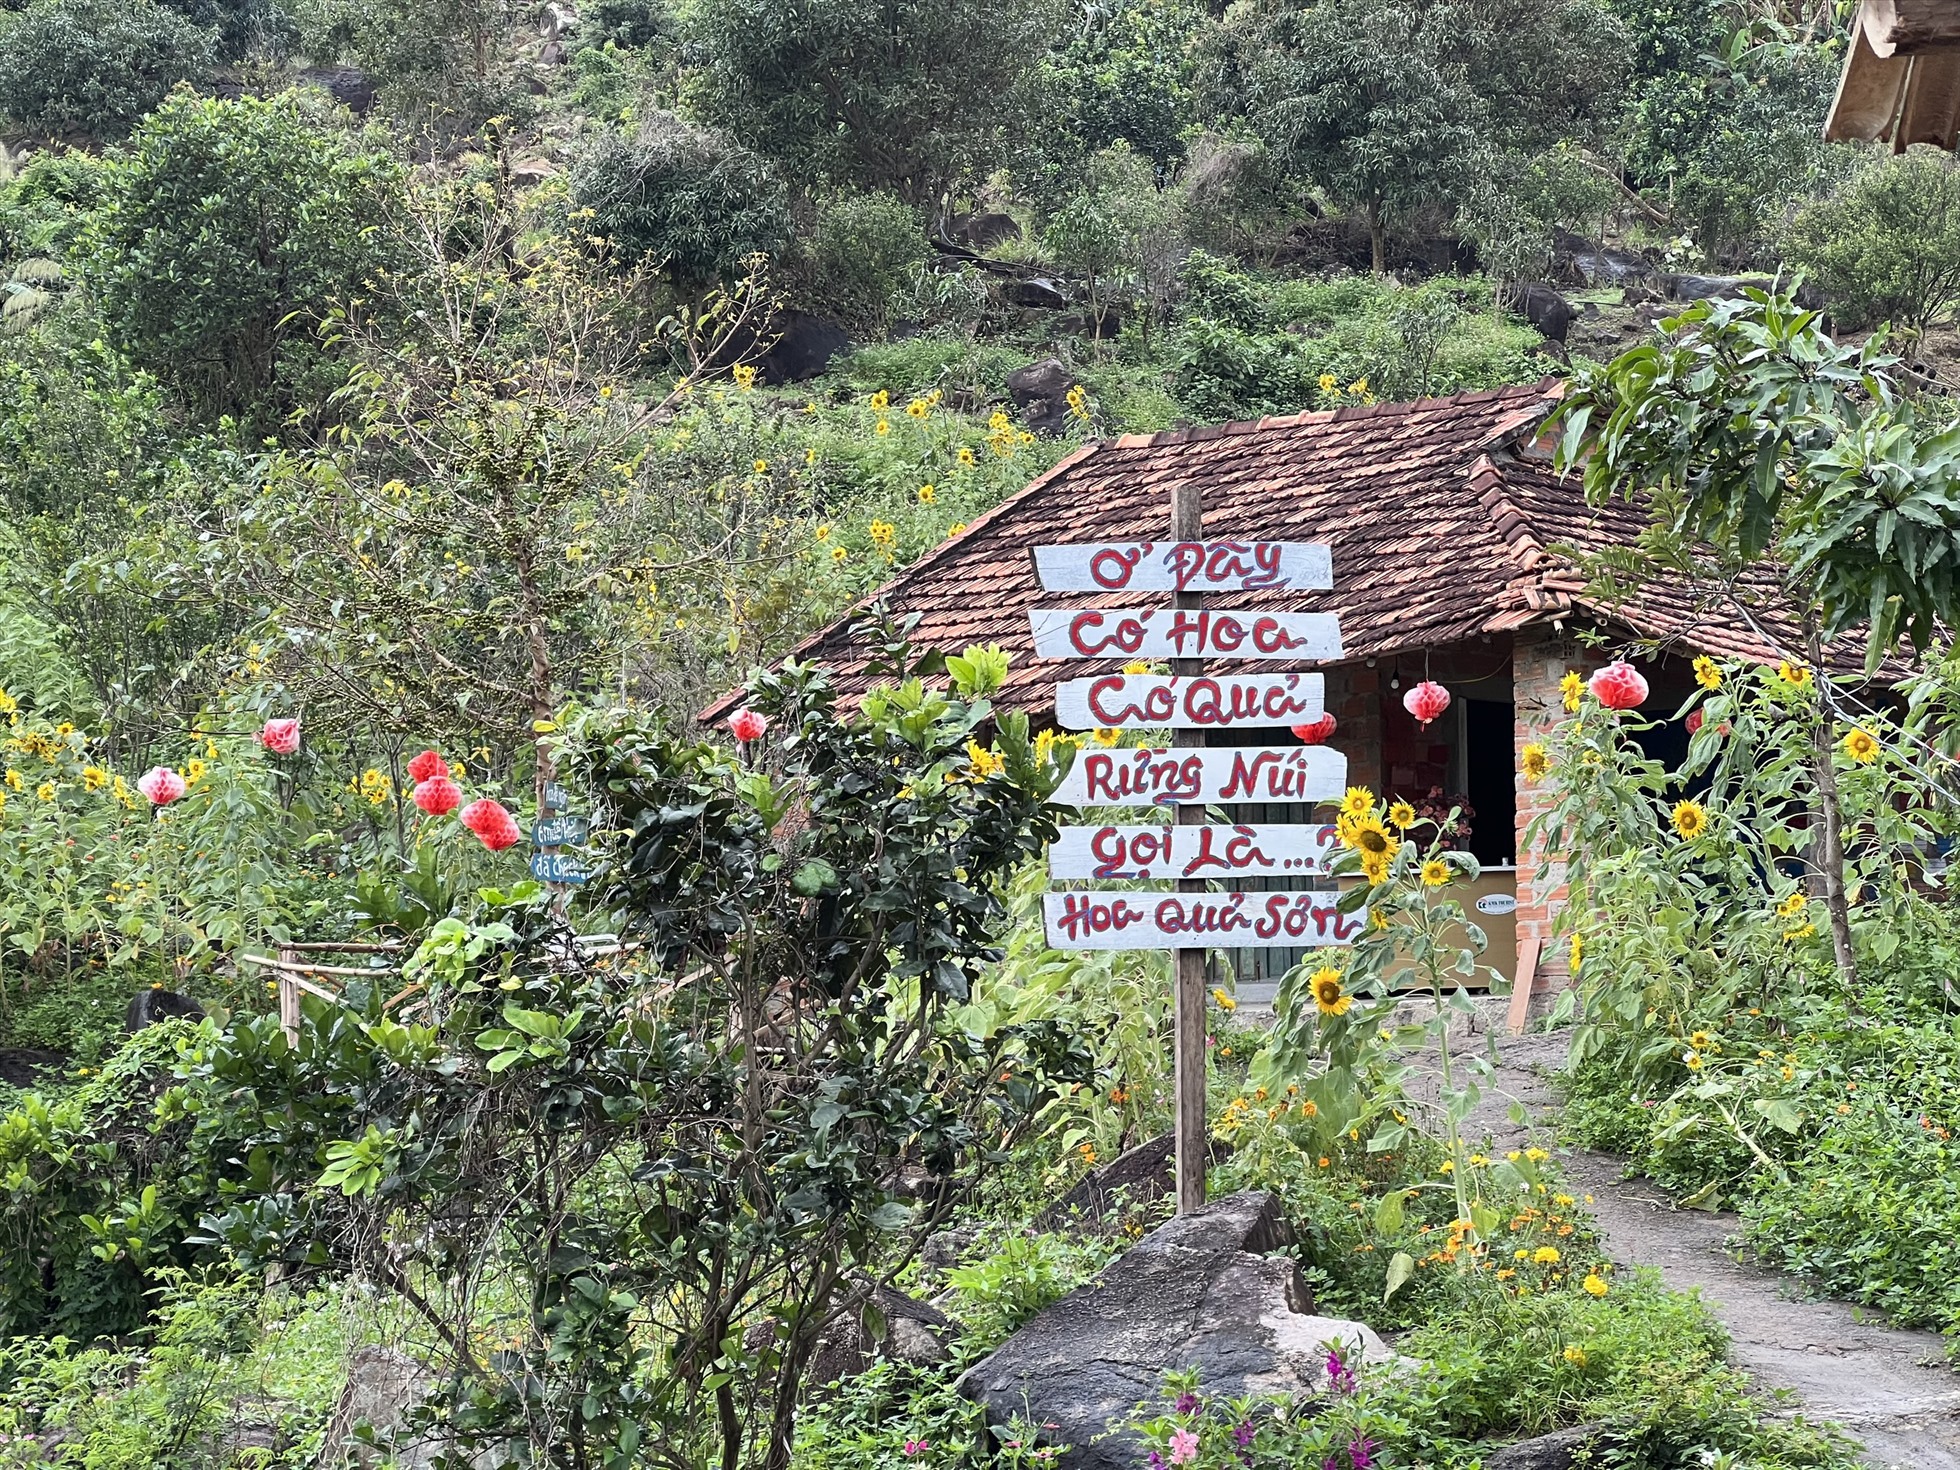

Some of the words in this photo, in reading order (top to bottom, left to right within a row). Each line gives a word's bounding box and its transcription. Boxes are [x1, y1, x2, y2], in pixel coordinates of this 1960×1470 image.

[1069, 610, 1156, 657] Có
[1166, 610, 1308, 657] Hoa
[1218, 748, 1308, 799] Núi
[1058, 893, 1144, 941] Hoa
